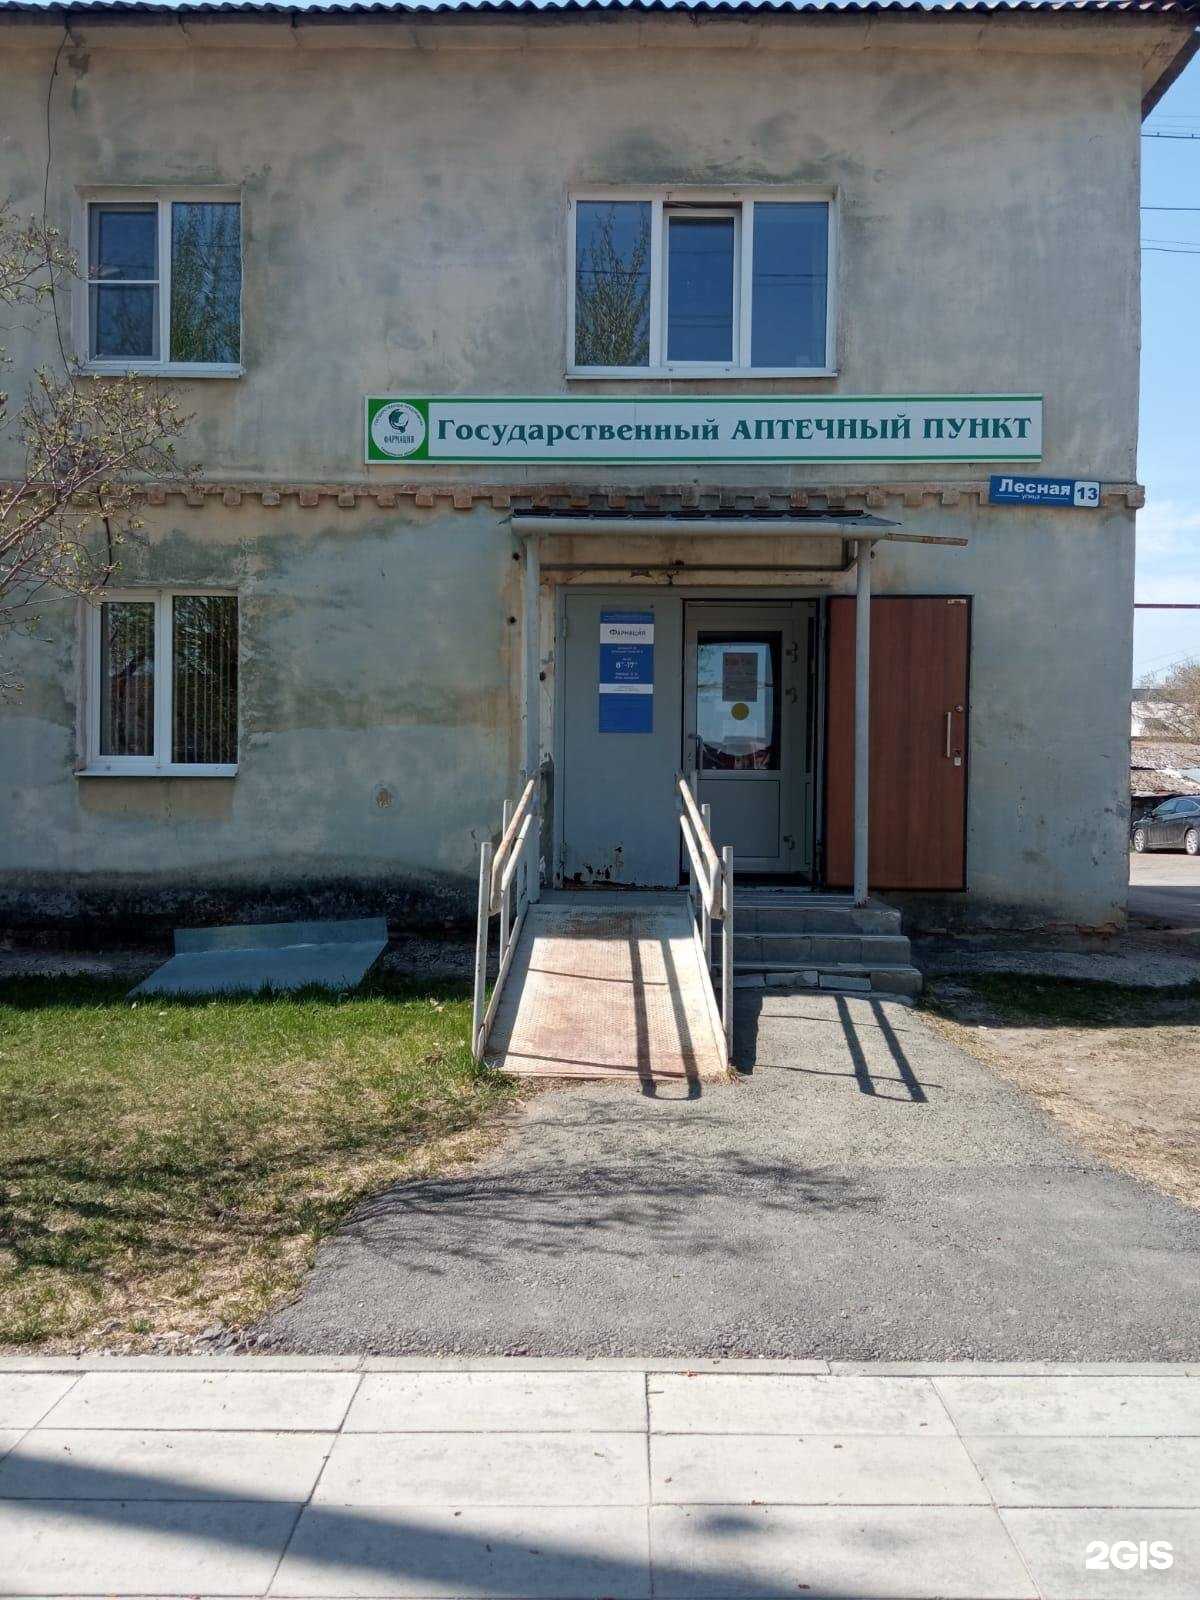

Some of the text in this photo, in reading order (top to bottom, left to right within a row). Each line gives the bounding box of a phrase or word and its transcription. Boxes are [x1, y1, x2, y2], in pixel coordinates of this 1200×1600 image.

[437, 413, 1032, 446] Государственный АПТЕЧНЫЙ ПУНКТ
[999, 479, 1098, 500] Лесная 13
